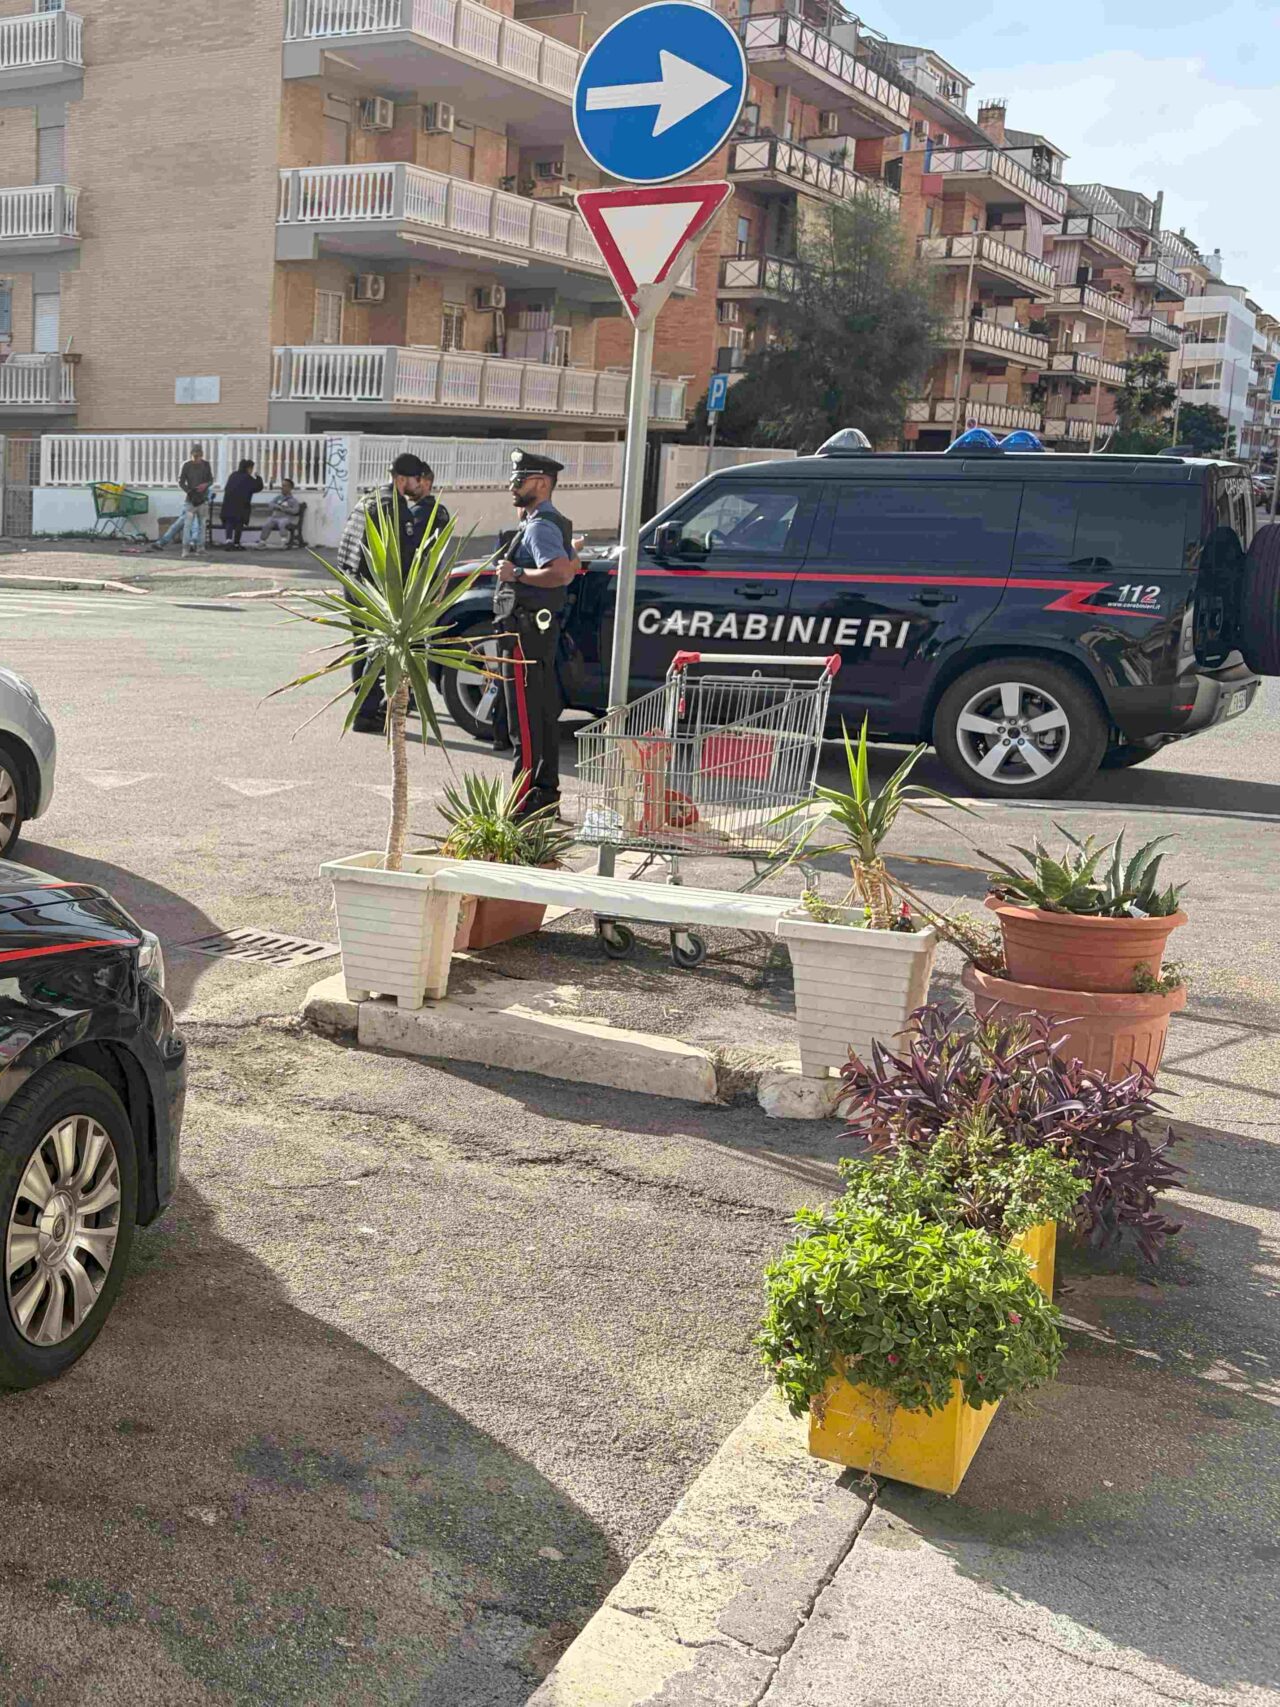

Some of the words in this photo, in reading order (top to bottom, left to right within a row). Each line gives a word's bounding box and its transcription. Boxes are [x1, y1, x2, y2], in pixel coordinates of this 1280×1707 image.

[710, 378, 724, 407] P
[1119, 584, 1161, 603] 112
[637, 607, 911, 649] CARABINIERI
